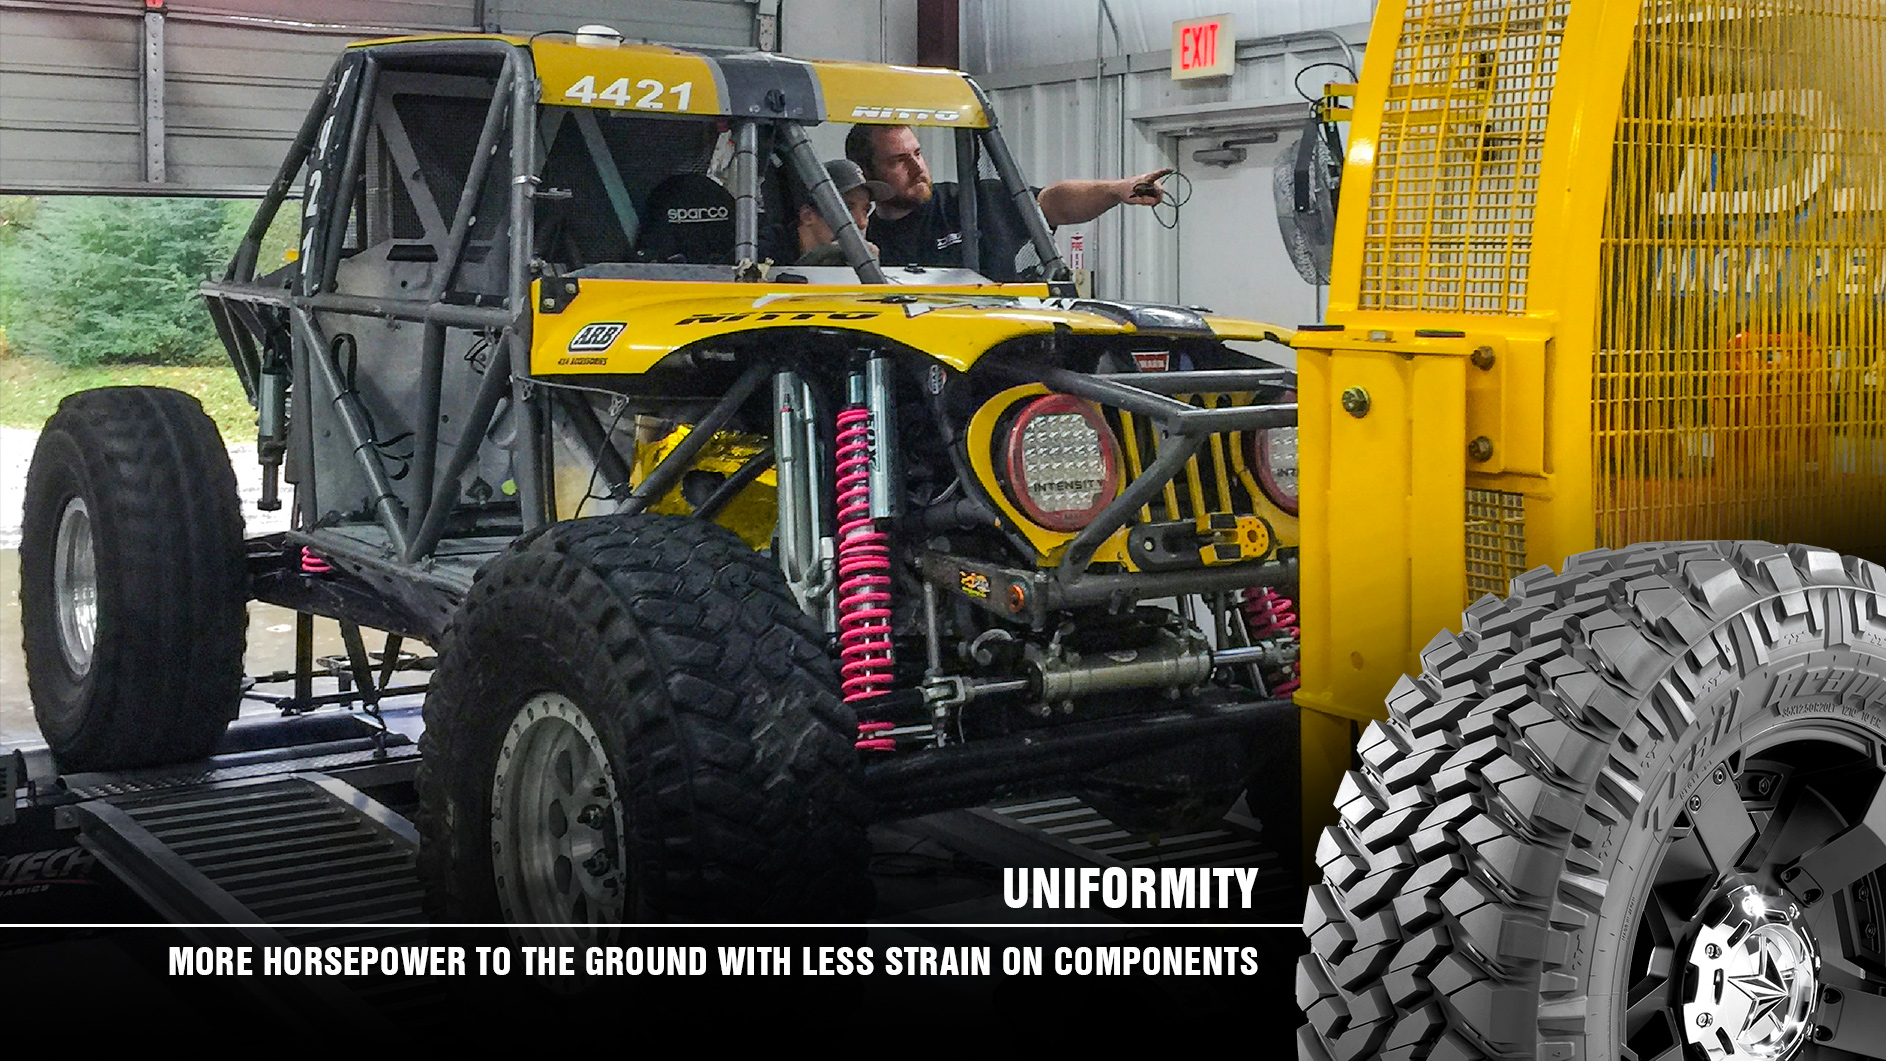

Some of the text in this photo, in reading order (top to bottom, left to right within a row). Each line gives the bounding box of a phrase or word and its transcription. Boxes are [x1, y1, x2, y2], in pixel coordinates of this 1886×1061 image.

[1181, 24, 1219, 71] EXIT
[565, 75, 693, 112] 4421
[851, 105, 960, 121] NITTO
[667, 206, 729, 224] sparco
[675, 311, 882, 326] NITTO
[573, 326, 618, 345] ARB
[1033, 479, 1102, 492] INTENSITY
[0, 846, 97, 882] TECH
